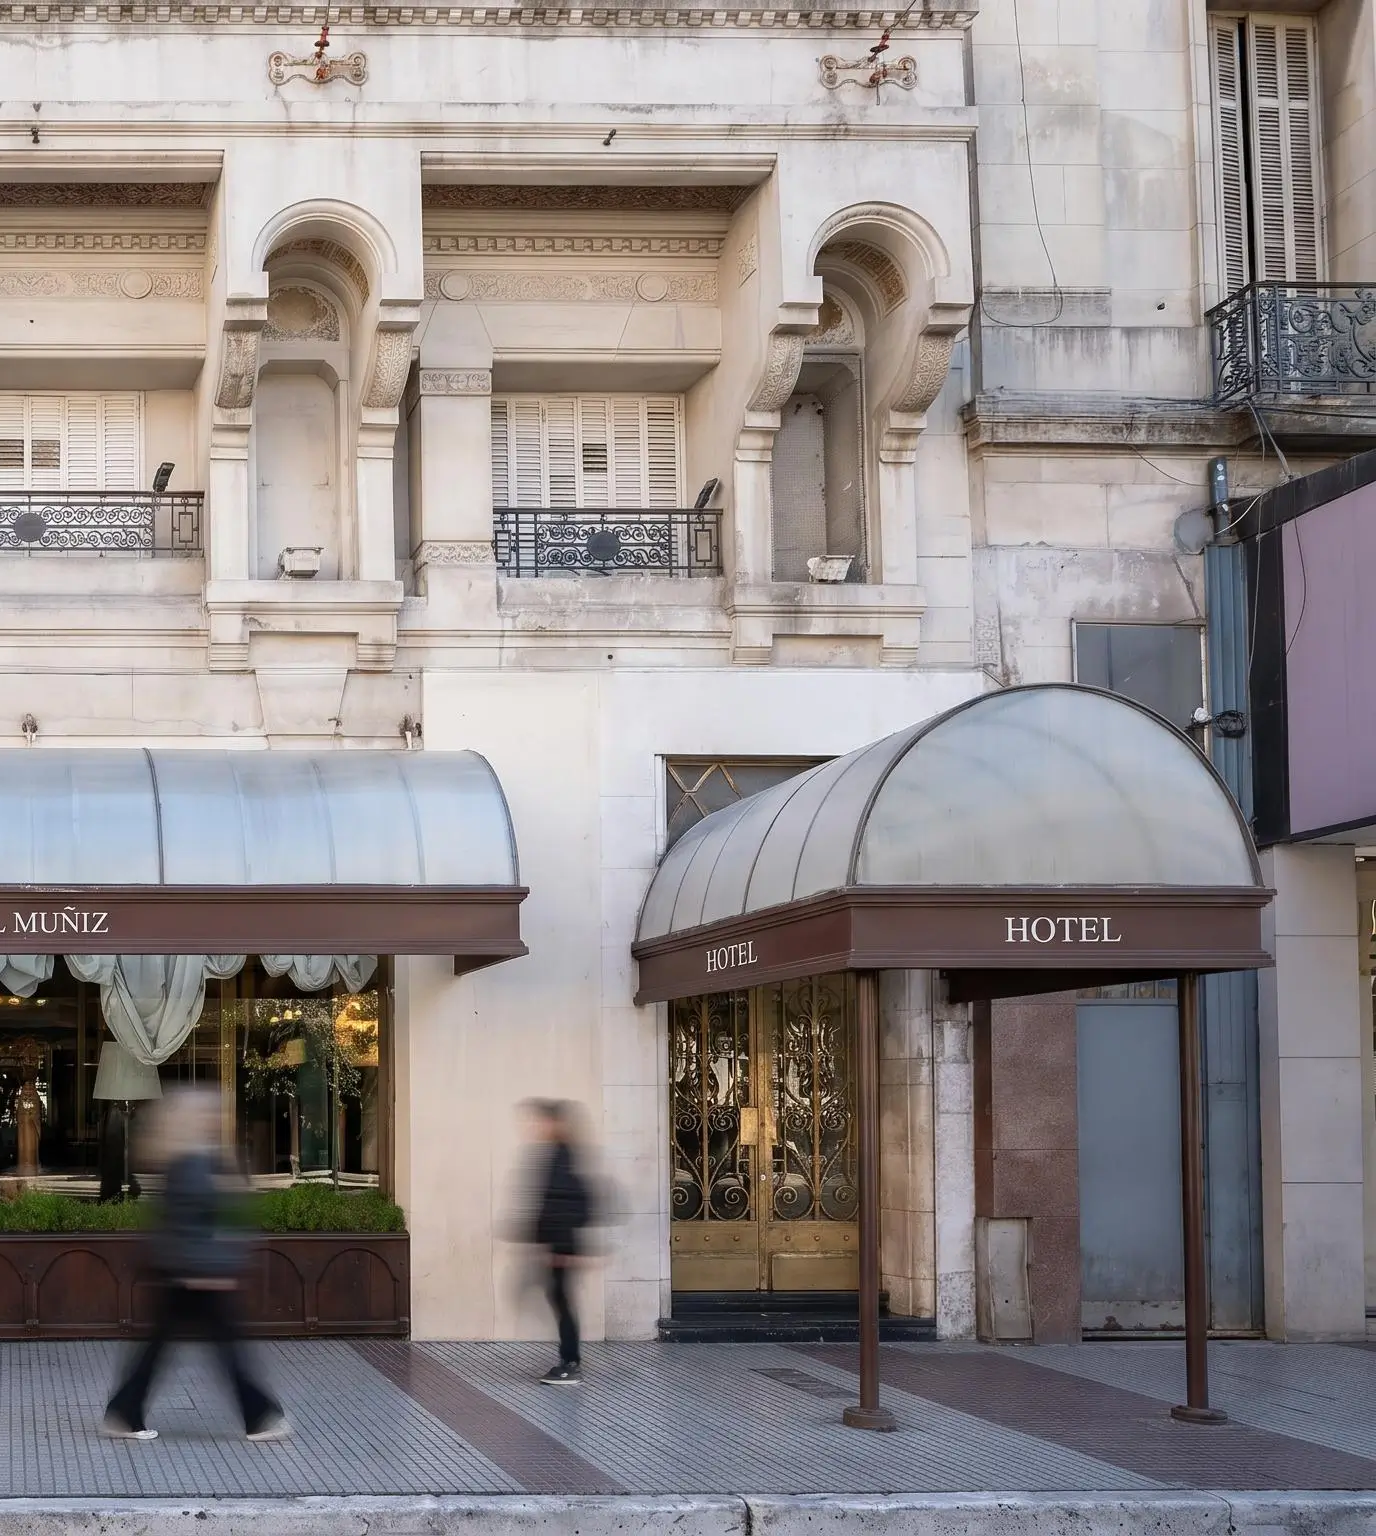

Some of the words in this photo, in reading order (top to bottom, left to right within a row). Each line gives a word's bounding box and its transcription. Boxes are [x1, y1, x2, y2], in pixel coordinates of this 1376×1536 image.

[13, 905, 109, 934] MUÑIZ
[1004, 916, 1122, 943] HOTEL
[706, 940, 758, 973] HOTEL
